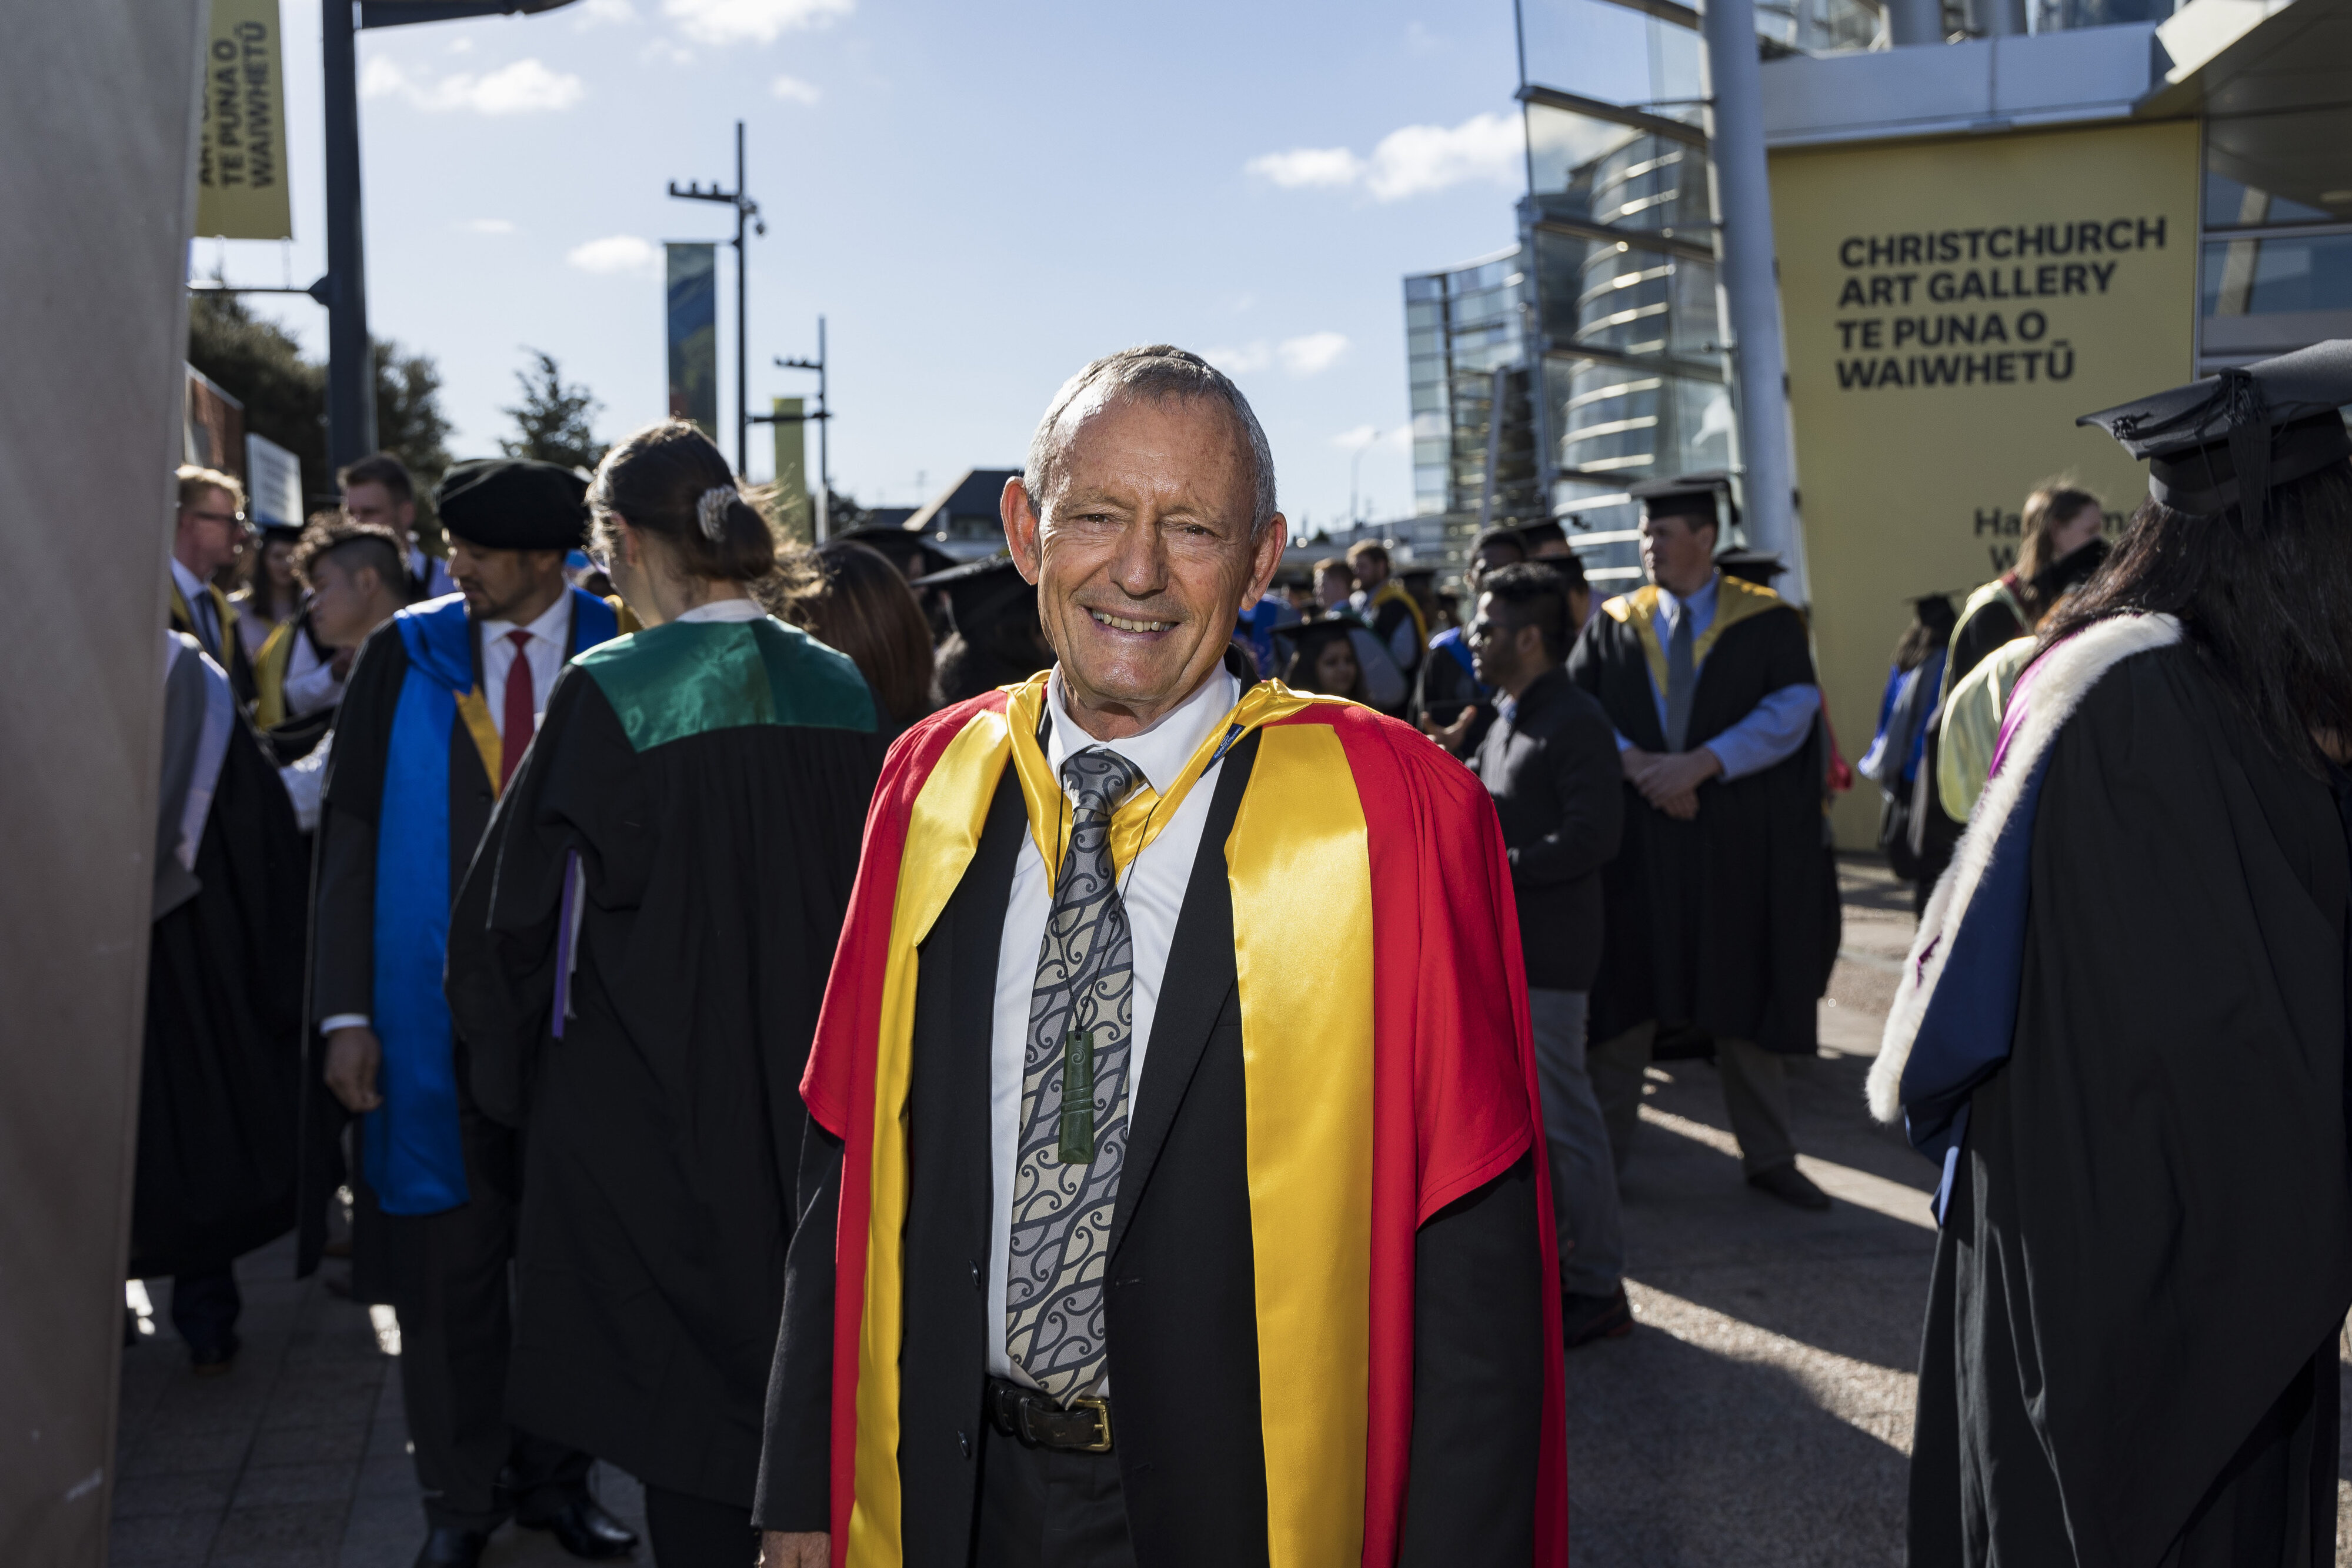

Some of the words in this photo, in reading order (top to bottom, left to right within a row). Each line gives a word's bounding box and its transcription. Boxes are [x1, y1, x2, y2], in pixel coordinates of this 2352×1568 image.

[212, 38, 236, 61] O
[215, 66, 241, 146] PUNA
[234, 21, 274, 188] WAIWHETŪ
[219, 154, 243, 186] TE
[1838, 216, 2167, 269] CHRISTCHURCH
[1838, 273, 1919, 309] ART
[1927, 261, 2117, 303] GALLERY
[1836, 318, 1883, 351] TE
[1893, 312, 2009, 348] PUNA
[2016, 309, 2048, 342] O
[1836, 339, 2075, 391] WAIWHETŪ
